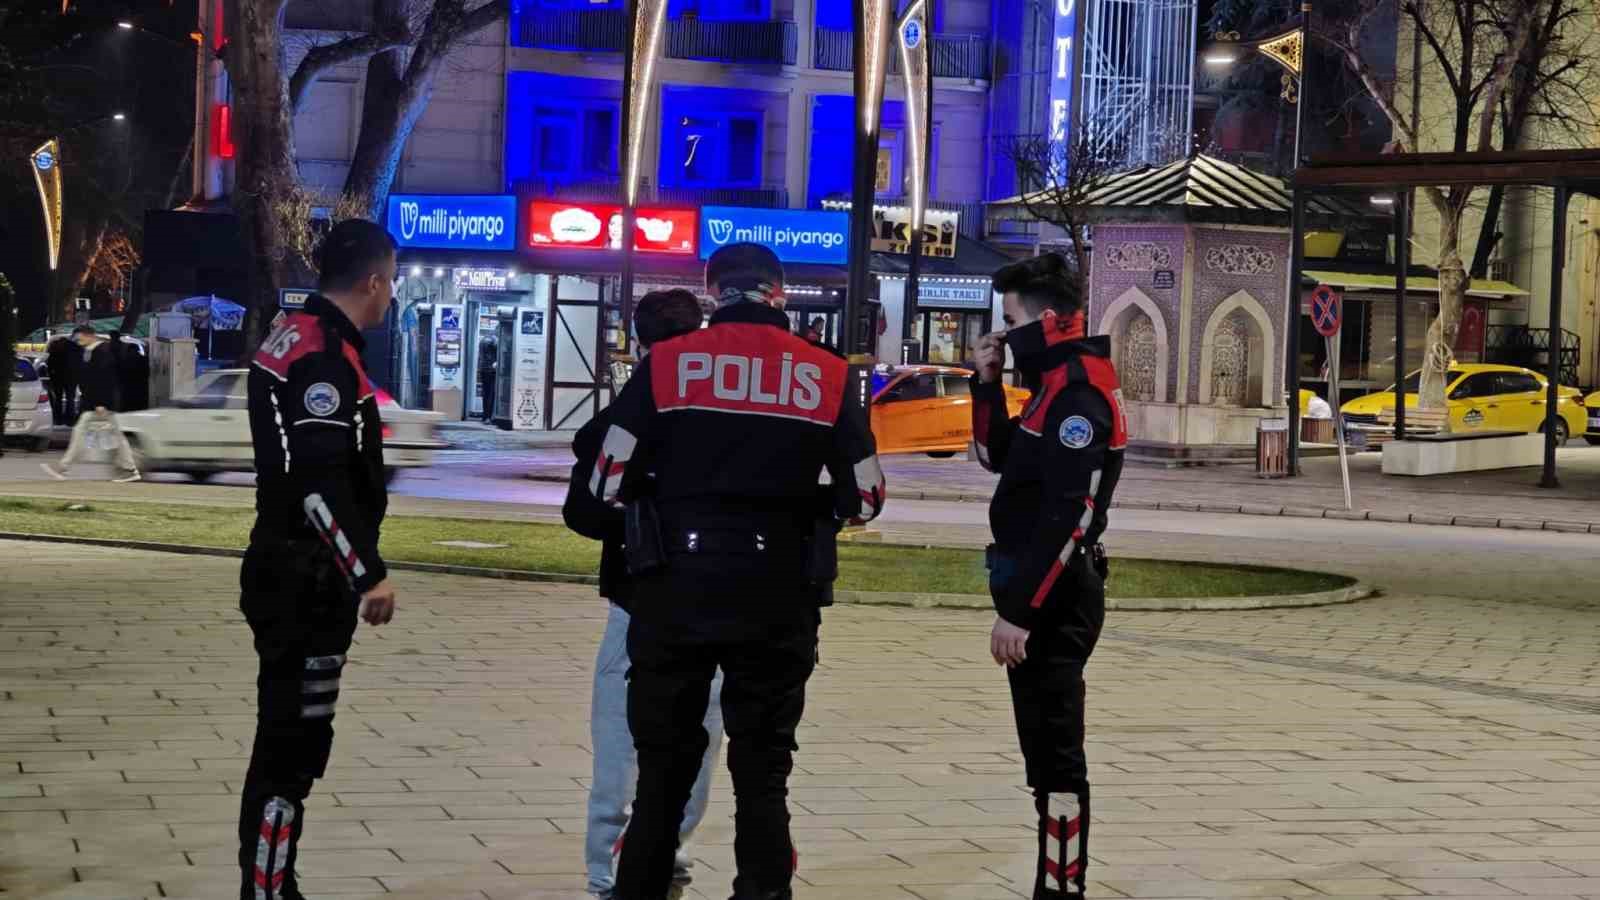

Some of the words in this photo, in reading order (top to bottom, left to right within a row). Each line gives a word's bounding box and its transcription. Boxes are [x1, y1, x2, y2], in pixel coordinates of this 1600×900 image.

[419, 207, 447, 234] milli
[448, 209, 504, 241] piyango
[735, 224, 772, 244] milli
[774, 227, 844, 248] piyango
[678, 352, 821, 410] POLİS
